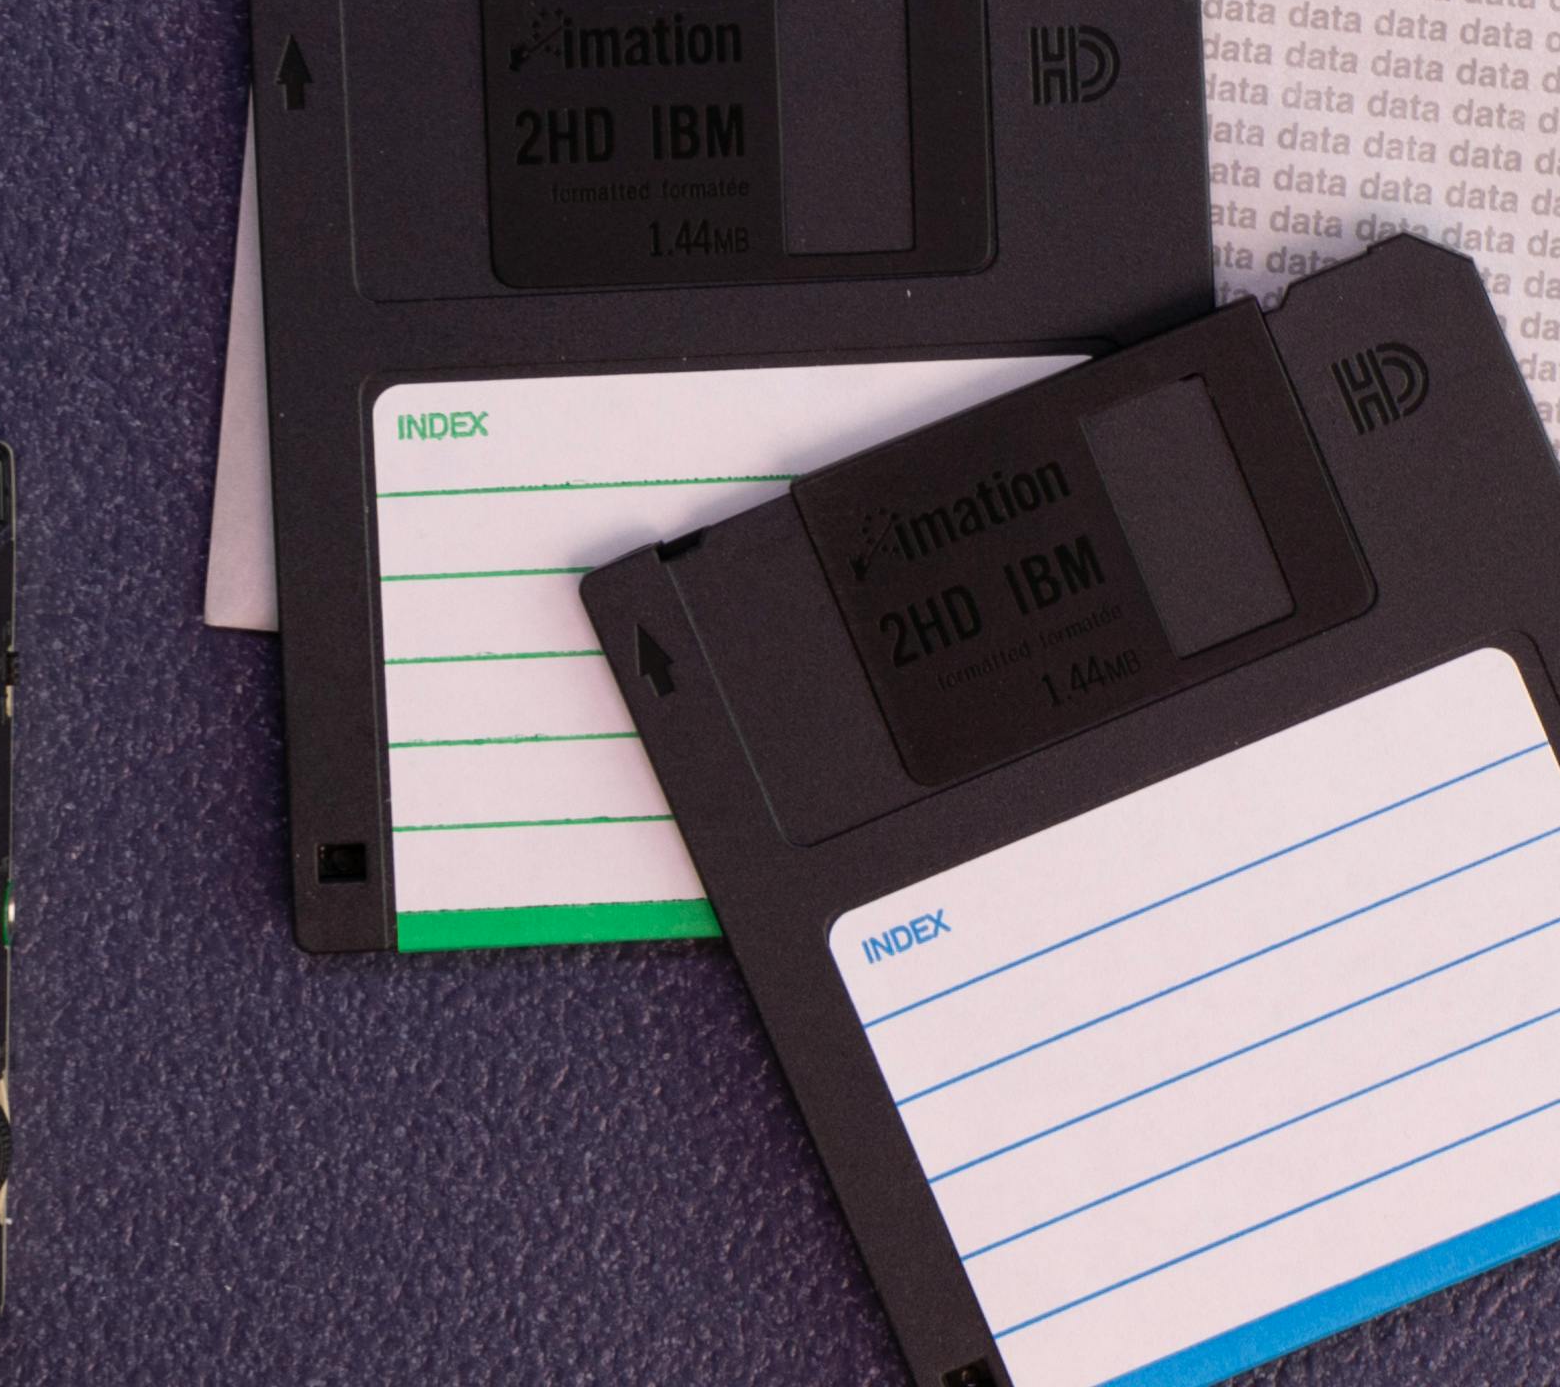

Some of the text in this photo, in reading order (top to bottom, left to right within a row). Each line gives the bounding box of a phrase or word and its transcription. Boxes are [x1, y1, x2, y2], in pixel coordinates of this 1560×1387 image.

[563, 18, 743, 69] imation
[1030, 25, 1122, 106] HD
[515, 103, 747, 167] 2HD IBM
[649, 218, 750, 257] 1.44MB
[1329, 342, 1430, 435] HD
[396, 410, 489, 442] INDEX
[893, 458, 1070, 560] imation
[877, 536, 1106, 668] 2HD IBM
[1041, 649, 1142, 708] 1.44MB
[861, 910, 951, 964] INDEX
